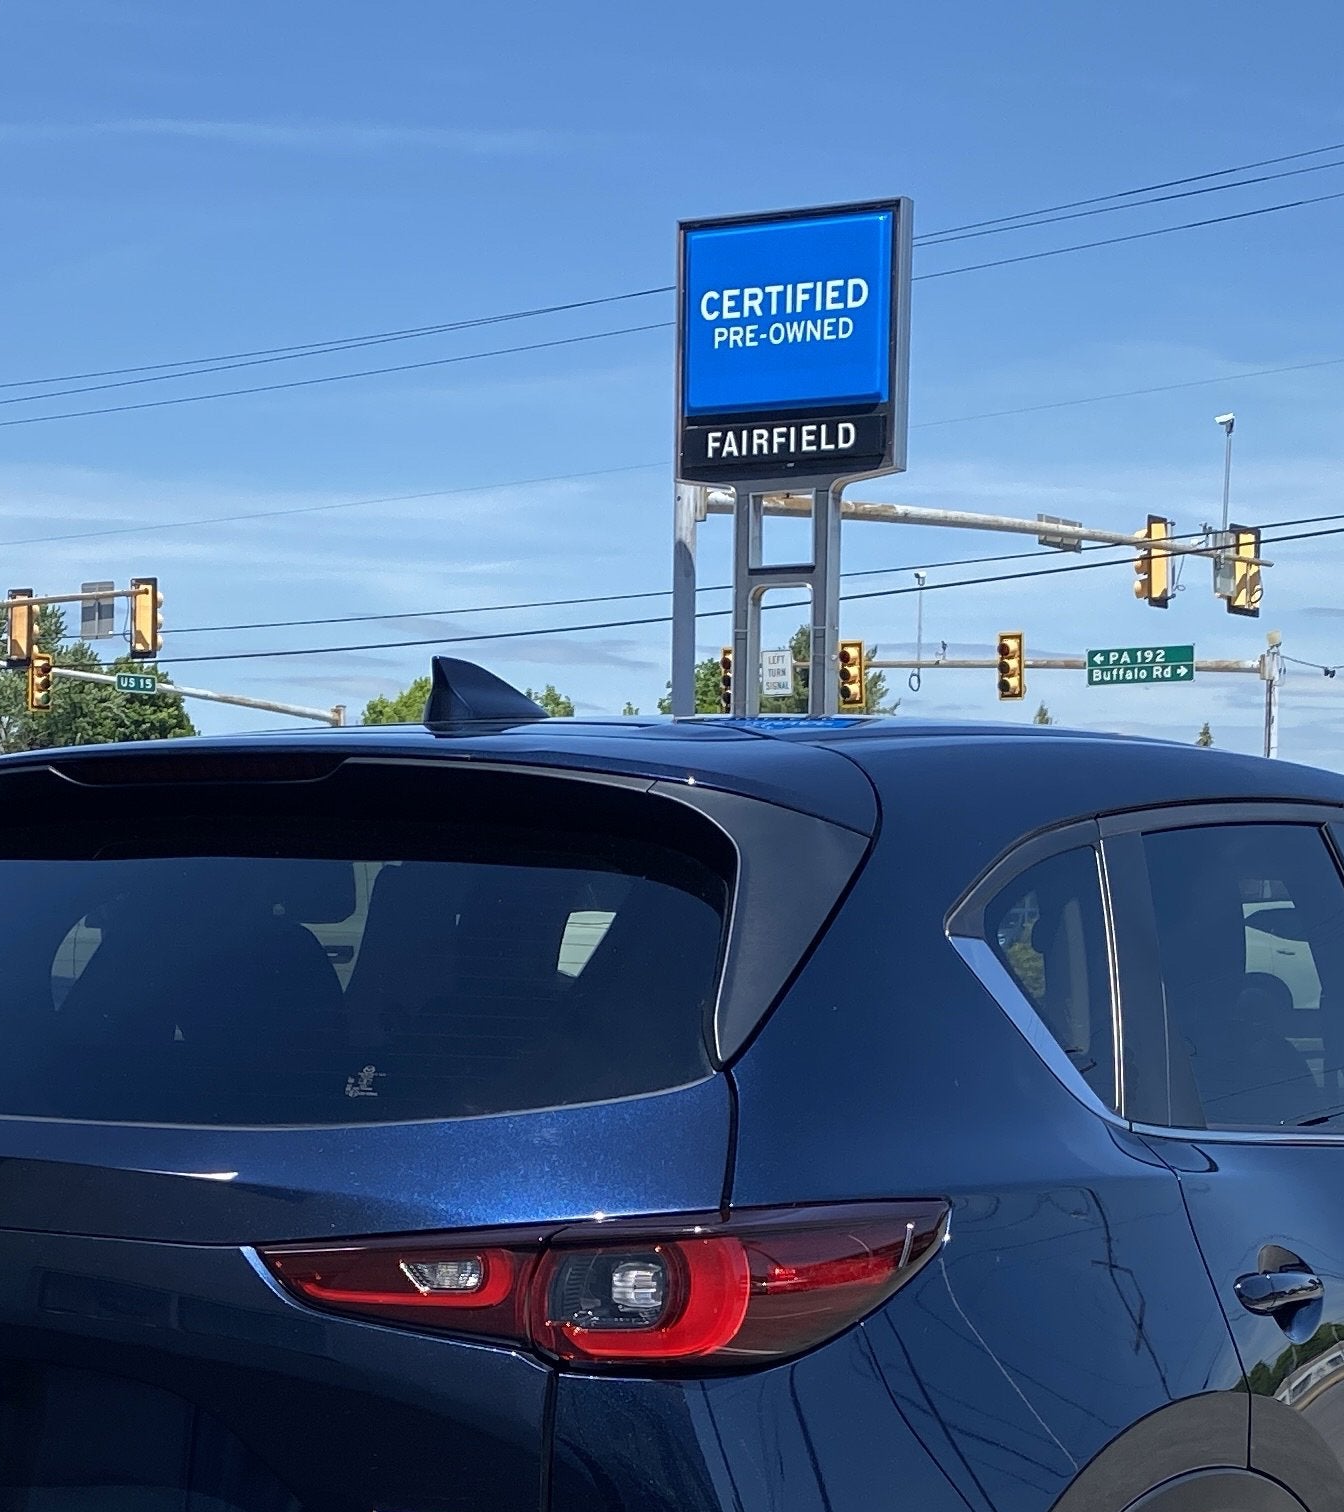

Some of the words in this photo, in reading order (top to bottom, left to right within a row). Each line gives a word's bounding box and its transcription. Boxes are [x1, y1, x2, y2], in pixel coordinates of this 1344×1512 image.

[700, 277, 869, 321] CERTIFIED
[713, 317, 854, 349] PRE-OWNED
[706, 422, 856, 459] FAIRFIELD
[768, 655, 785, 664] LEFT
[1109, 651, 1131, 665] PA
[1136, 649, 1166, 663] 192
[768, 668, 786, 677] TURN
[1092, 667, 1148, 682] Buffalo
[1152, 665, 1172, 679] Rd
[120, 676, 136, 688] US
[139, 678, 153, 689] 15
[766, 681, 789, 690] SIGNAL
